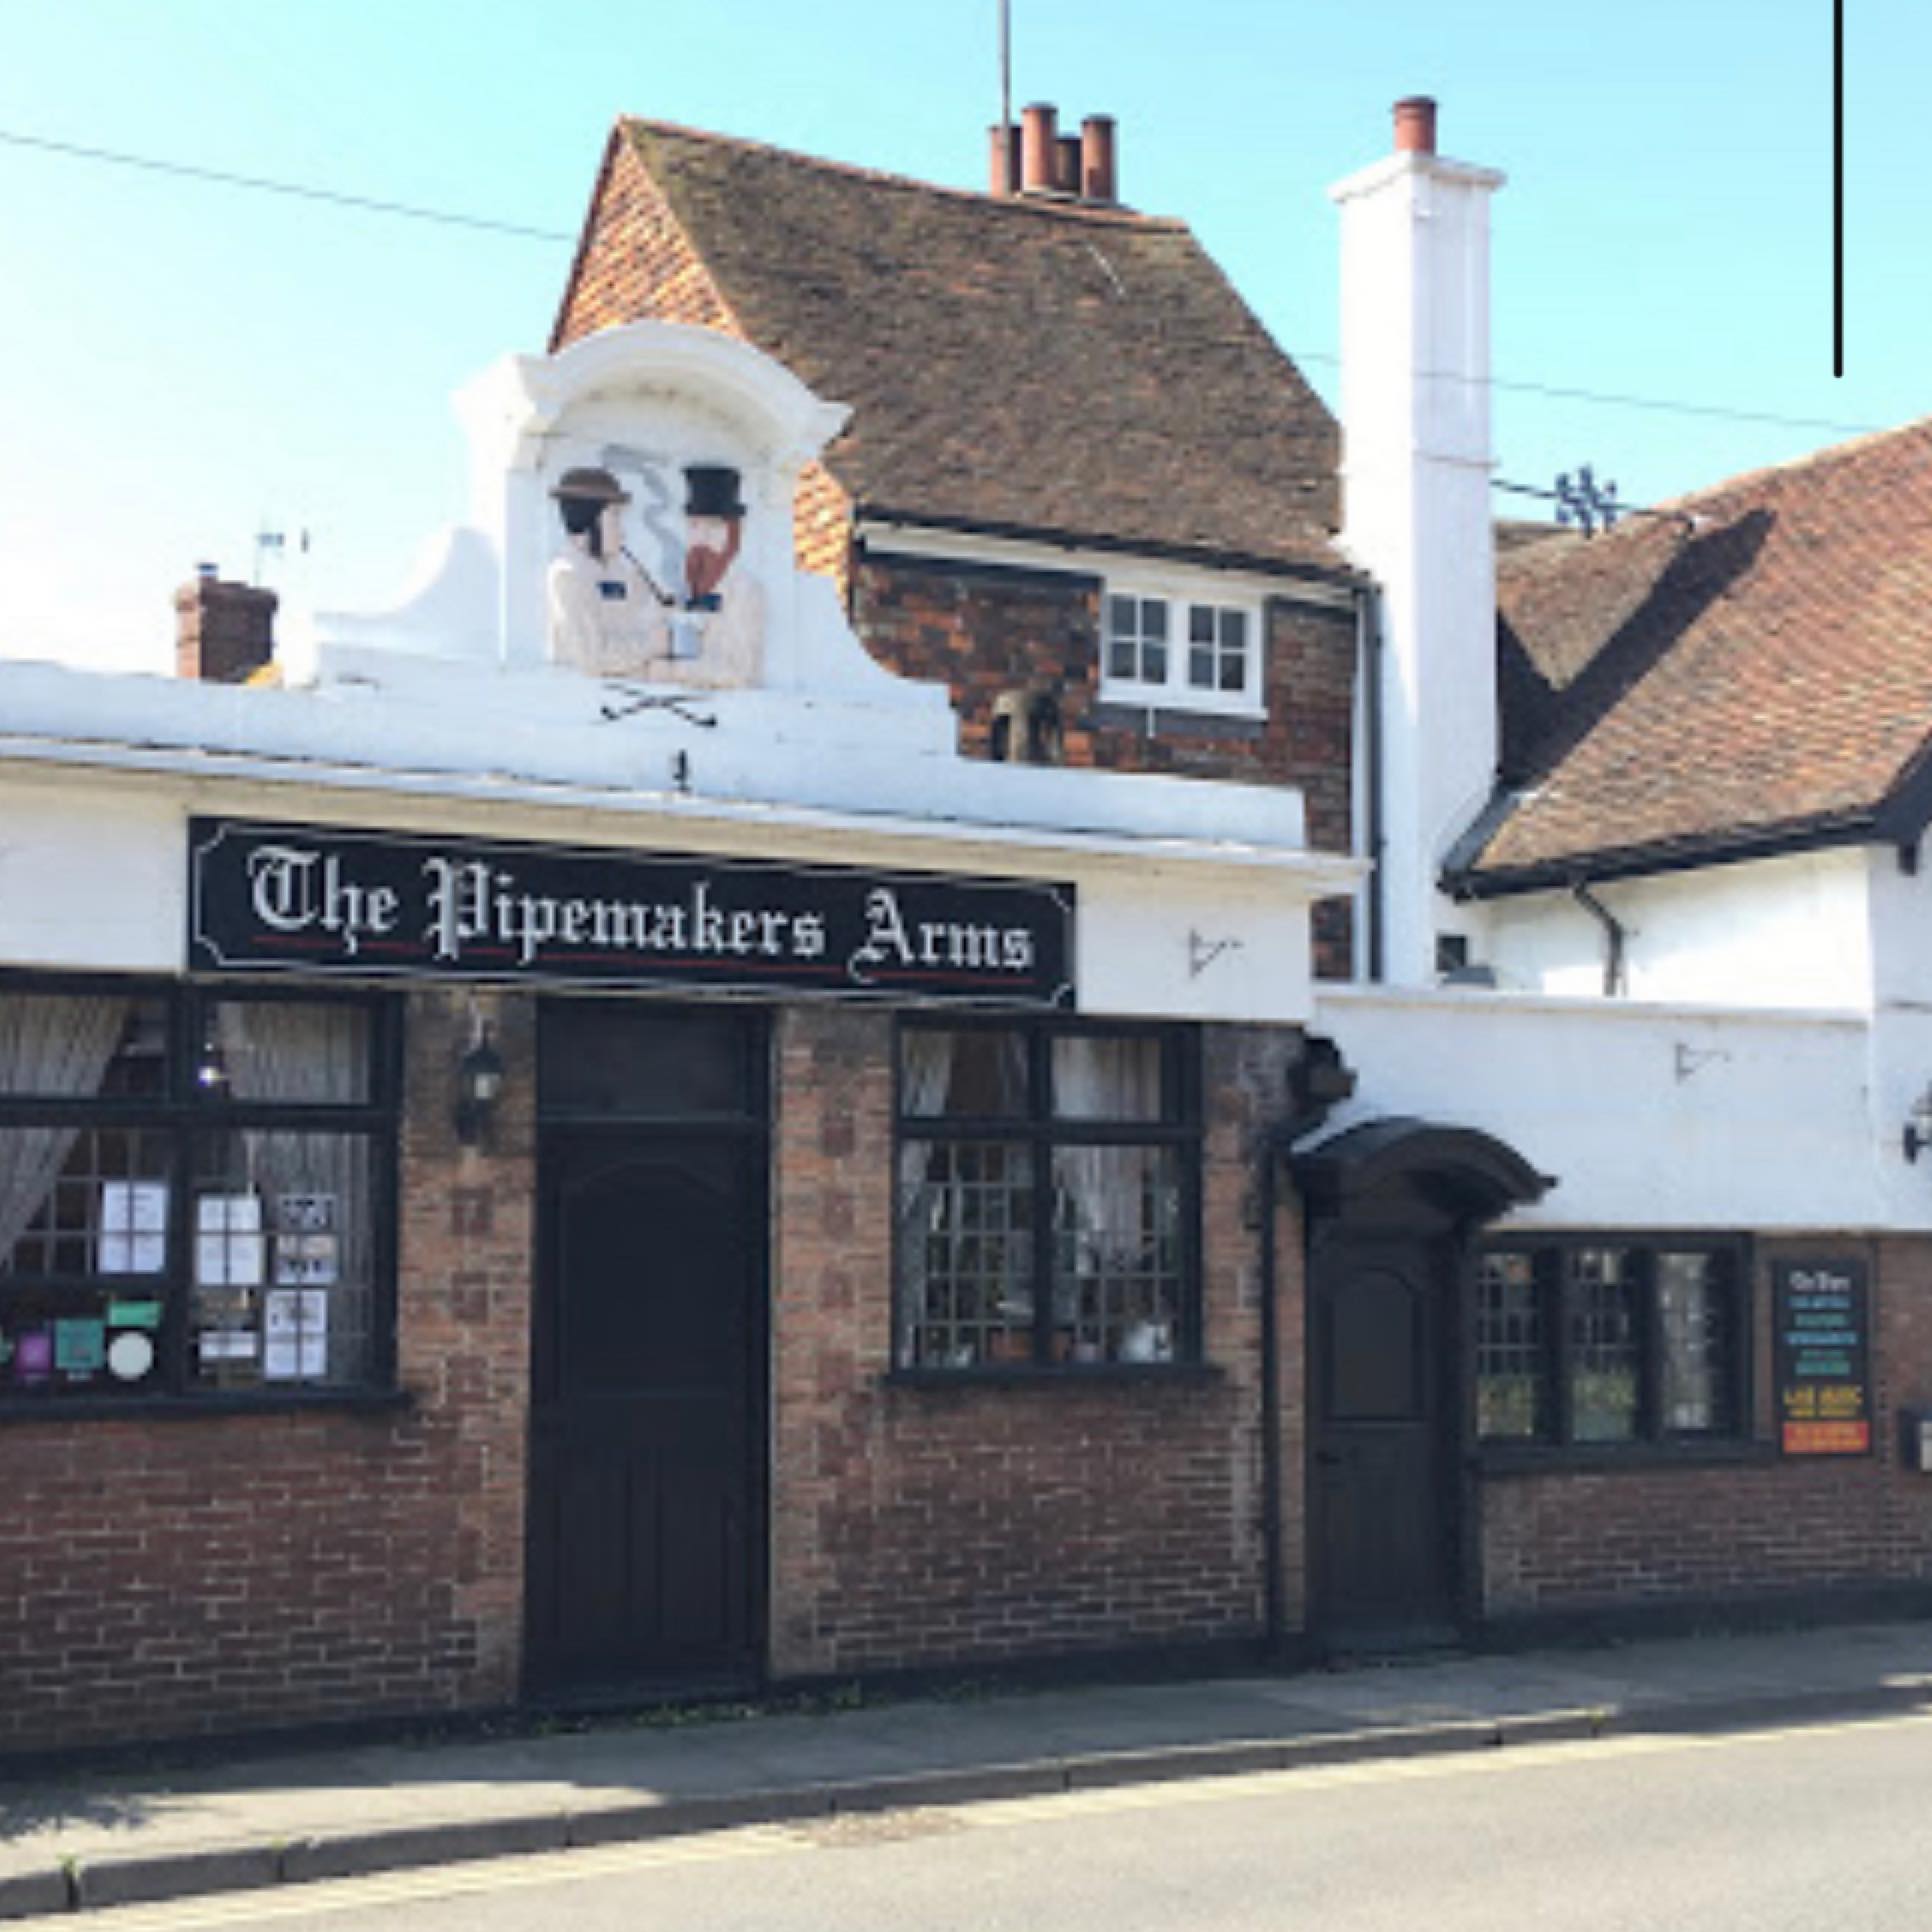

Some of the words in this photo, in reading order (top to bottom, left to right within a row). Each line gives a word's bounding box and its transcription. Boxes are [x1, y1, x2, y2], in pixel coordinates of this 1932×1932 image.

[249, 845, 398, 955] The
[422, 857, 826, 965] Pipemakers
[847, 887, 1034, 984] Arms
